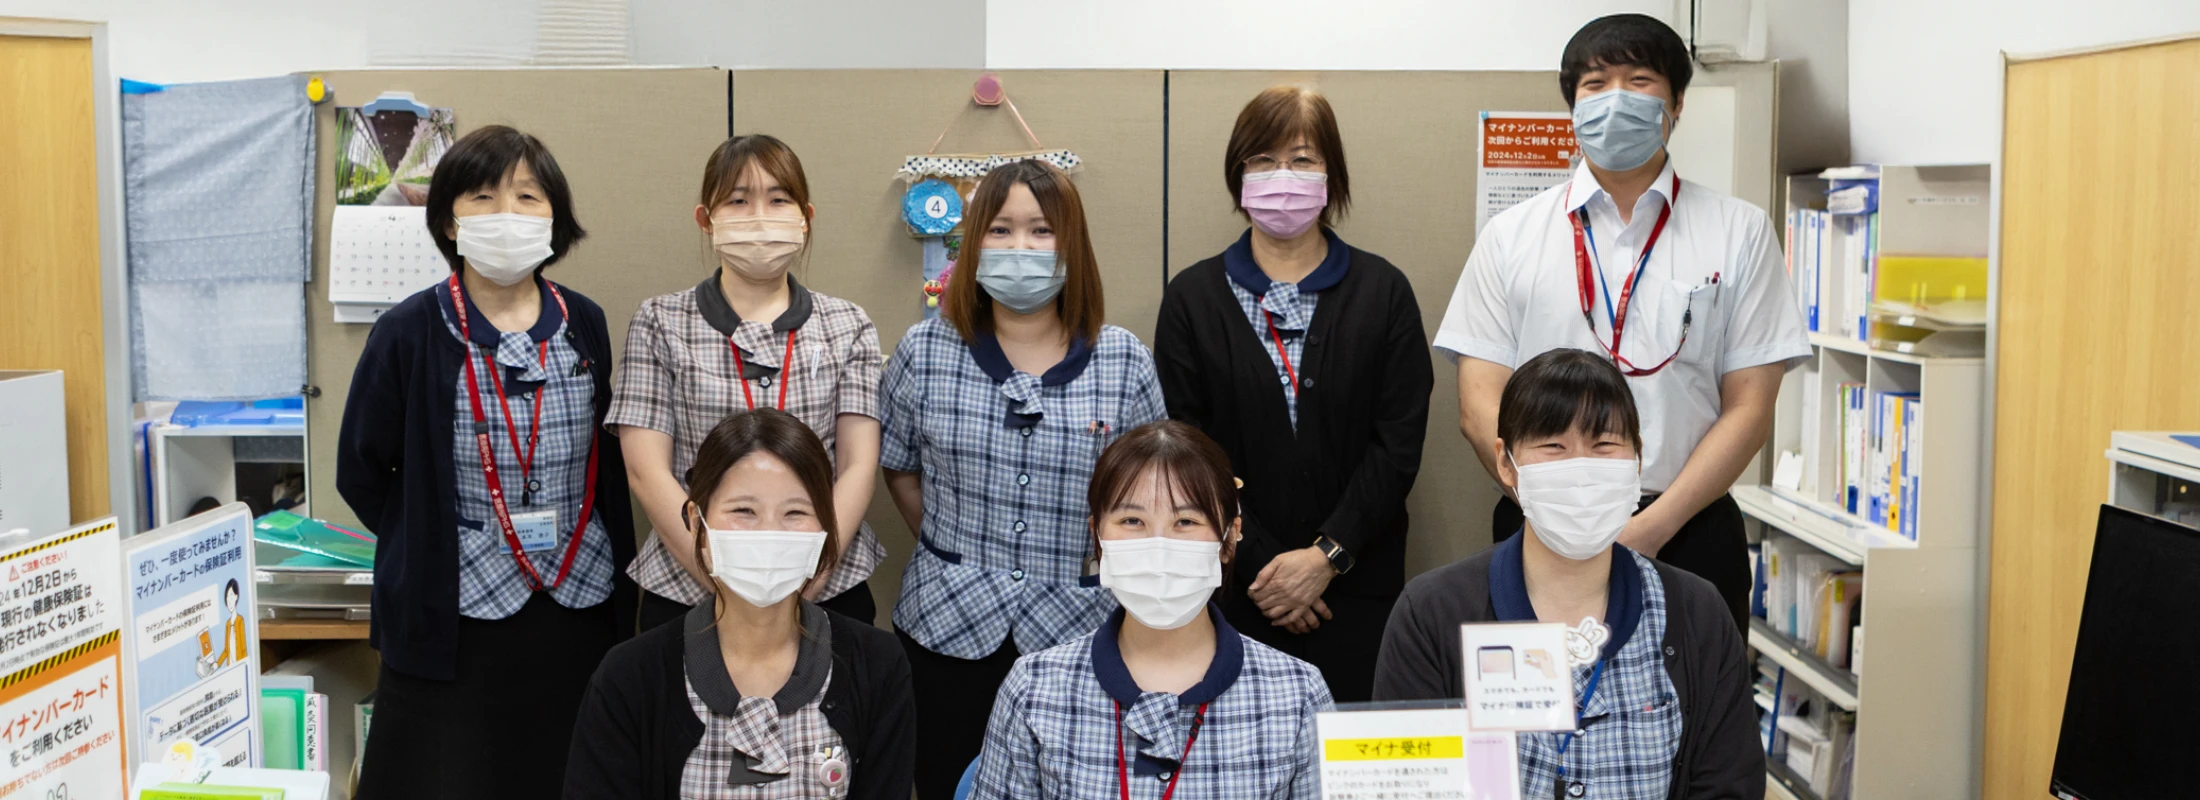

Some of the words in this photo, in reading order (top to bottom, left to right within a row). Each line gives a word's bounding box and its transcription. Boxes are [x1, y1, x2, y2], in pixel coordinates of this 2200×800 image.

[931, 200, 941, 214] 4
[136, 546, 242, 599] マイナンバーカードの保険証利用
[139, 529, 236, 577] ぜひ、一度使ってみませんか？
[1, 583, 92, 629] 現行の健康保険証は
[0, 674, 109, 744] イナンバーカード
[0, 730, 115, 799] お持ちでない方は次回ご持参ください
[10, 714, 93, 769] をご利用ください
[1355, 740, 1433, 757] マイナ受付
